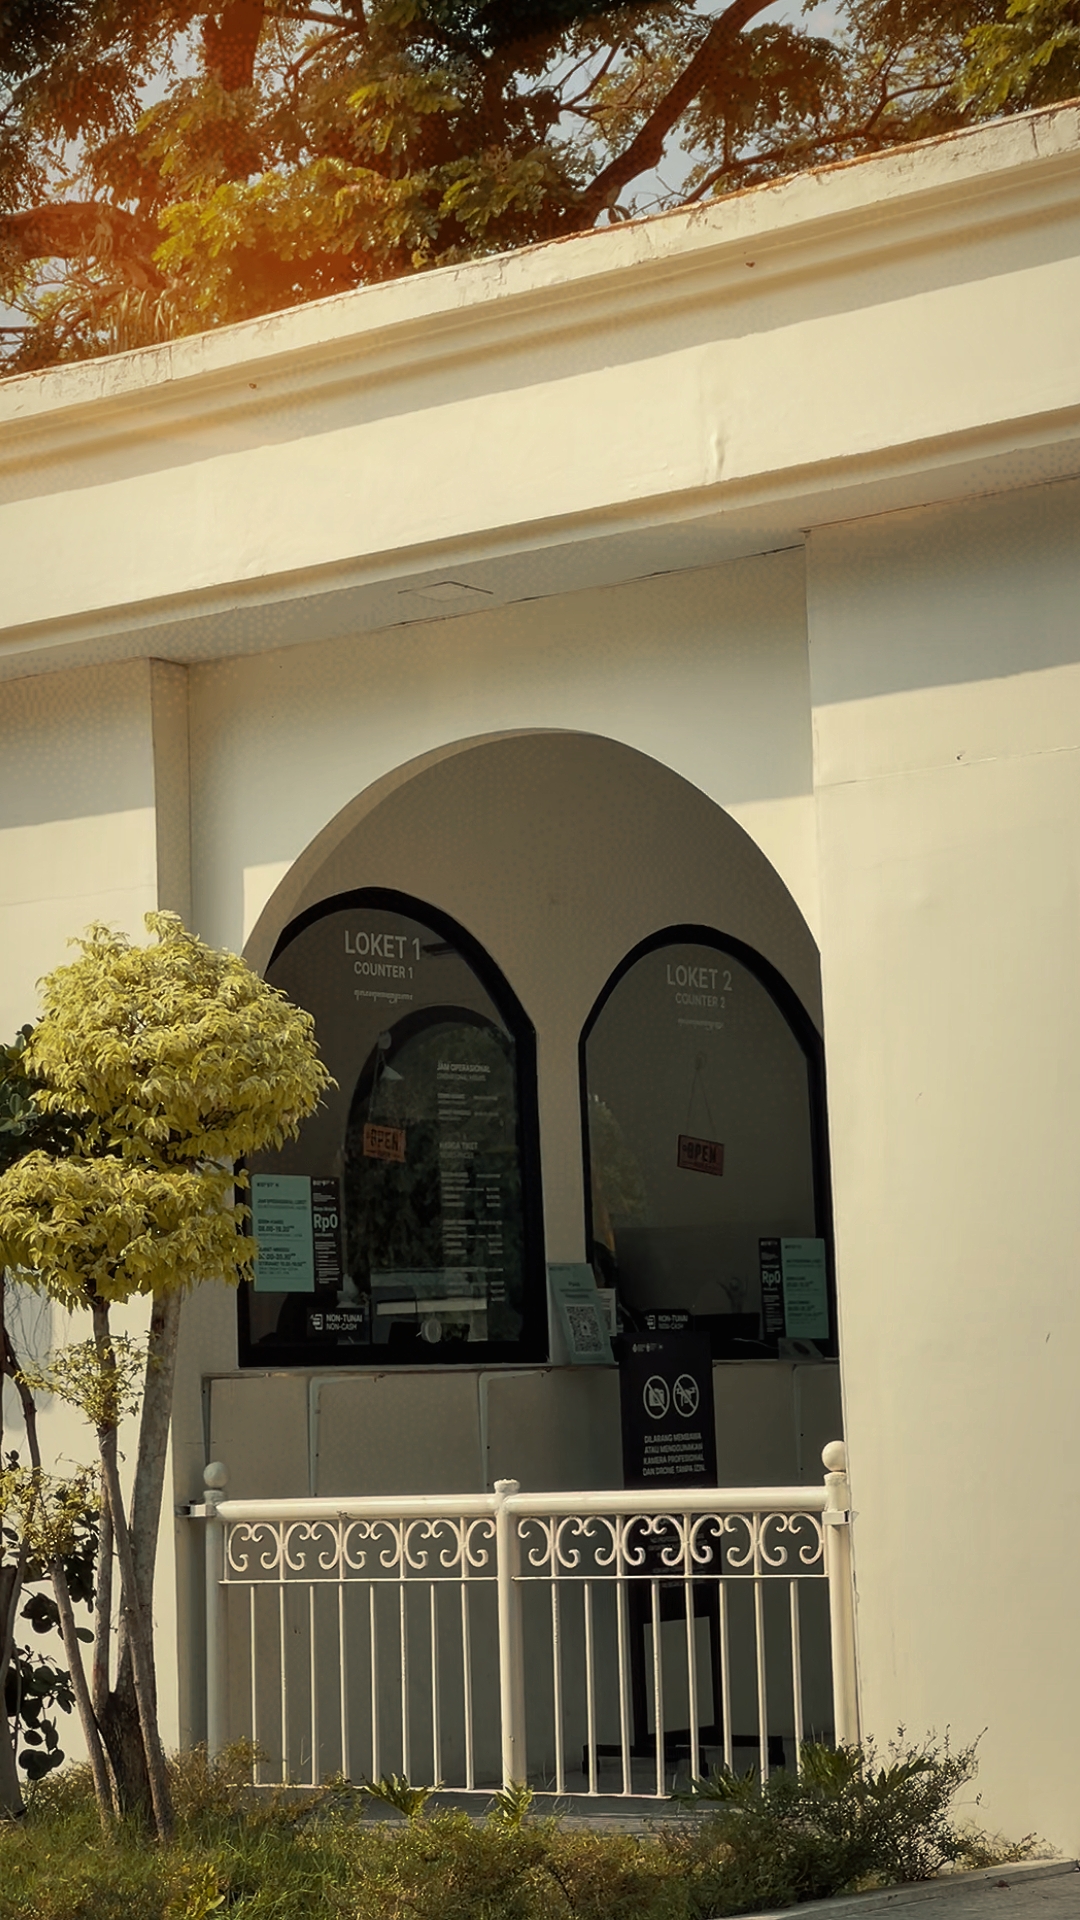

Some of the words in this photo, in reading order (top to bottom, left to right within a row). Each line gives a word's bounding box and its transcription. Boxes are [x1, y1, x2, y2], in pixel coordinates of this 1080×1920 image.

[345, 930, 407, 959] LOKET
[412, 937, 420, 961] 1
[354, 961, 405, 979] COUNTER
[408, 966, 413, 979] 1
[667, 964, 718, 990] LOKET
[723, 970, 733, 991] 2
[675, 992, 719, 1008] COUNTER
[720, 996, 726, 1009] 2
[371, 1128, 399, 1151] OPEN
[687, 1141, 717, 1164] OPEN
